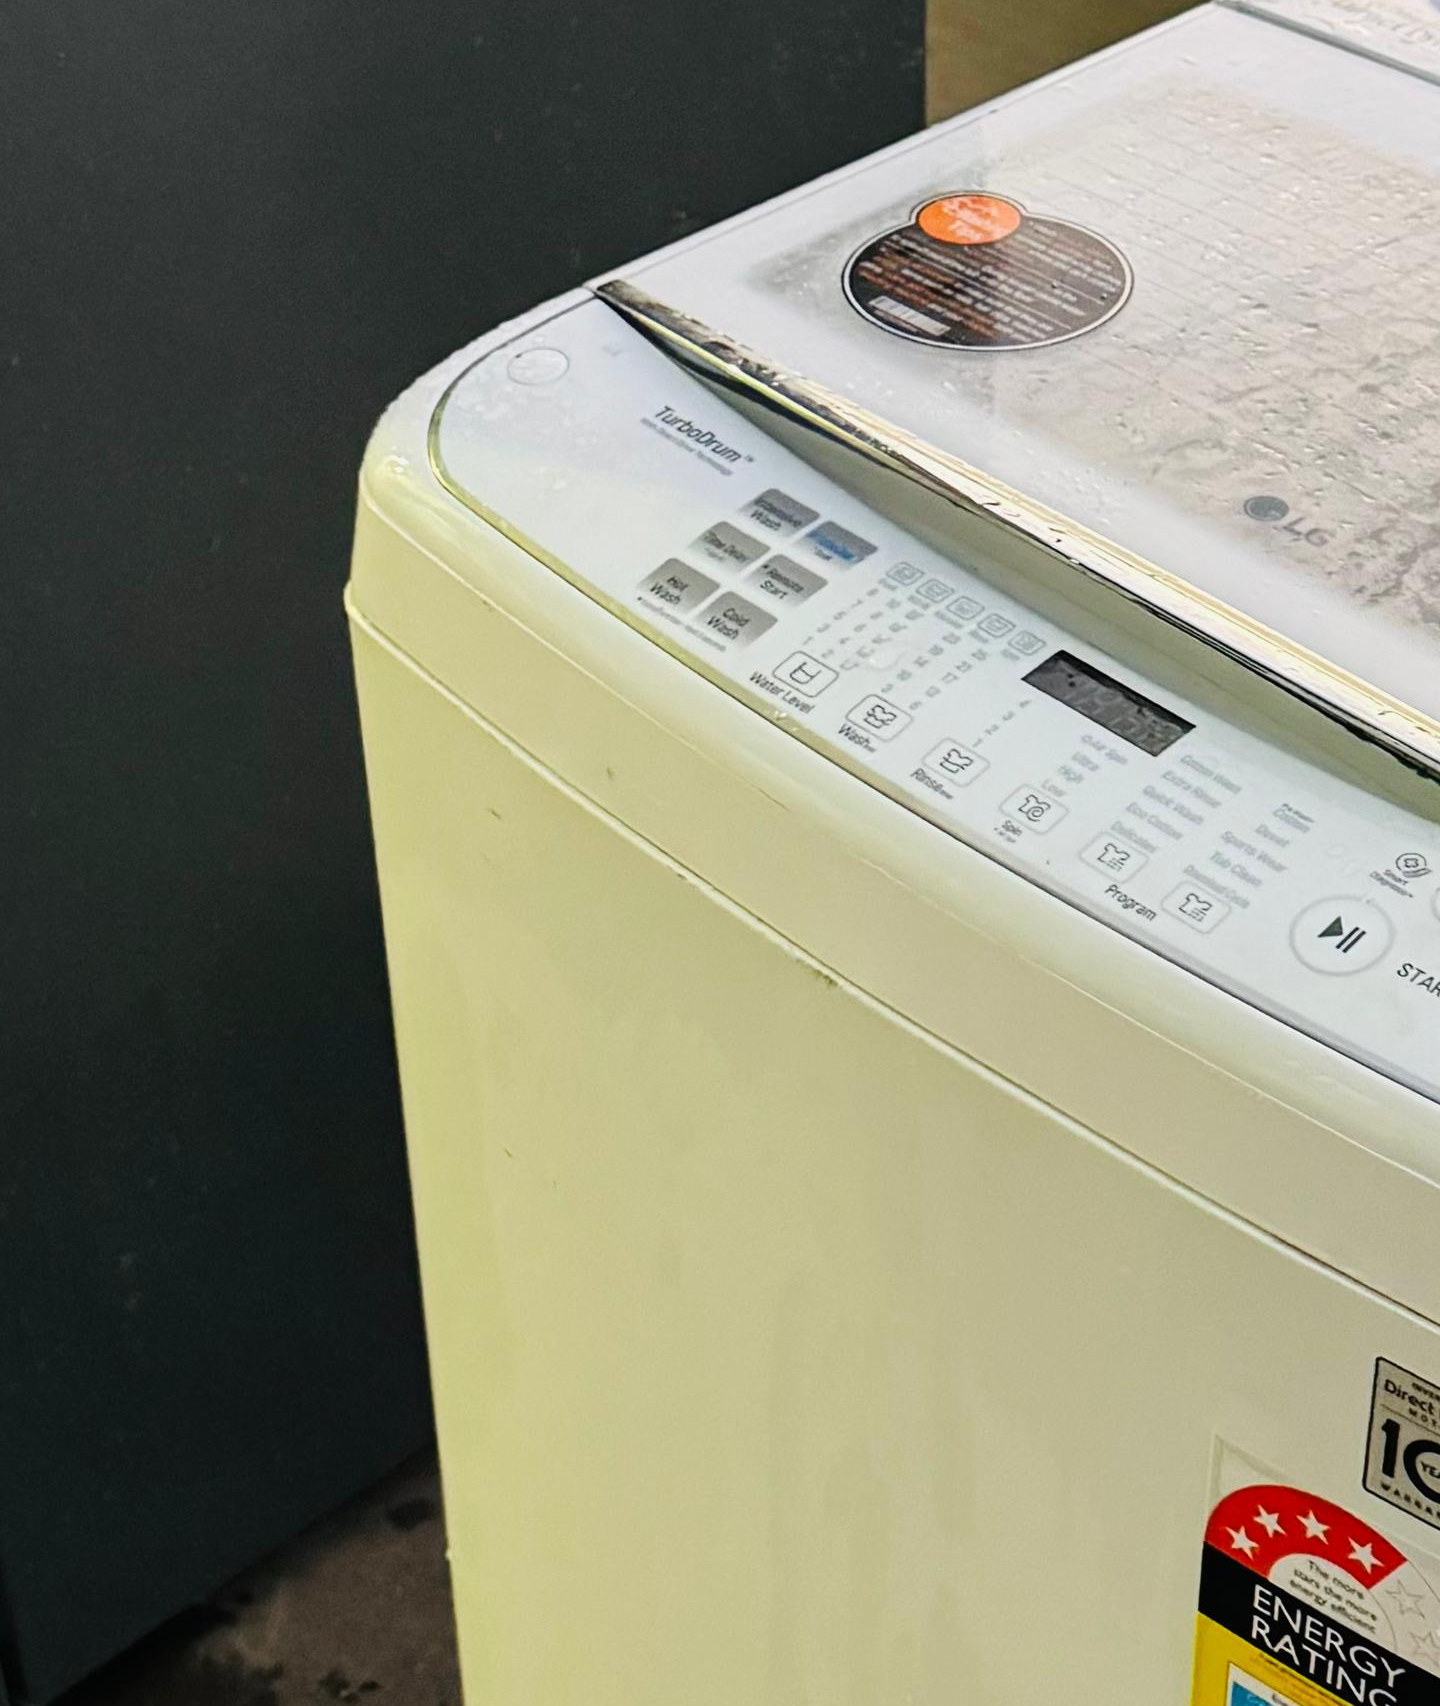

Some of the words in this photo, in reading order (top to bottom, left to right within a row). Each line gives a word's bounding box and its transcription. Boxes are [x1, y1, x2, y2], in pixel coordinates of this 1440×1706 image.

[750, 509, 782, 531] Wash
[650, 582, 681, 604] Wash
[666, 576, 689, 591] Hot
[759, 580, 789, 599] Start
[765, 568, 804, 593] Remote
[707, 615, 739, 639] Wash
[722, 607, 750, 627] Cold
[749, 672, 785, 695] Water
[781, 690, 815, 714] Level
[838, 723, 870, 748] Wash
[909, 767, 944, 792] Rinse
[1040, 779, 1067, 798] Low
[1161, 770, 1192, 791] Extra
[1142, 785, 1174, 807] Quick
[1172, 804, 1204, 825] Wash
[1220, 830, 1257, 856] Sports
[1256, 851, 1288, 872] Wear
[1209, 851, 1231, 869] Tub
[1230, 864, 1262, 887] Clean
[1383, 869, 1409, 886] Smart
[1104, 884, 1157, 921] Program
[1384, 1379, 1434, 1415] Direct
[1308, 1559, 1329, 1580] The
[1332, 1577, 1364, 1600] more
[1289, 1579, 1327, 1607] energy
[1330, 1603, 1376, 1634] efficient
[1293, 1569, 1320, 1589] stars
[1323, 1586, 1342, 1602] the
[1345, 1599, 1377, 1622] more
[1252, 1583, 1406, 1689] ENERGY
